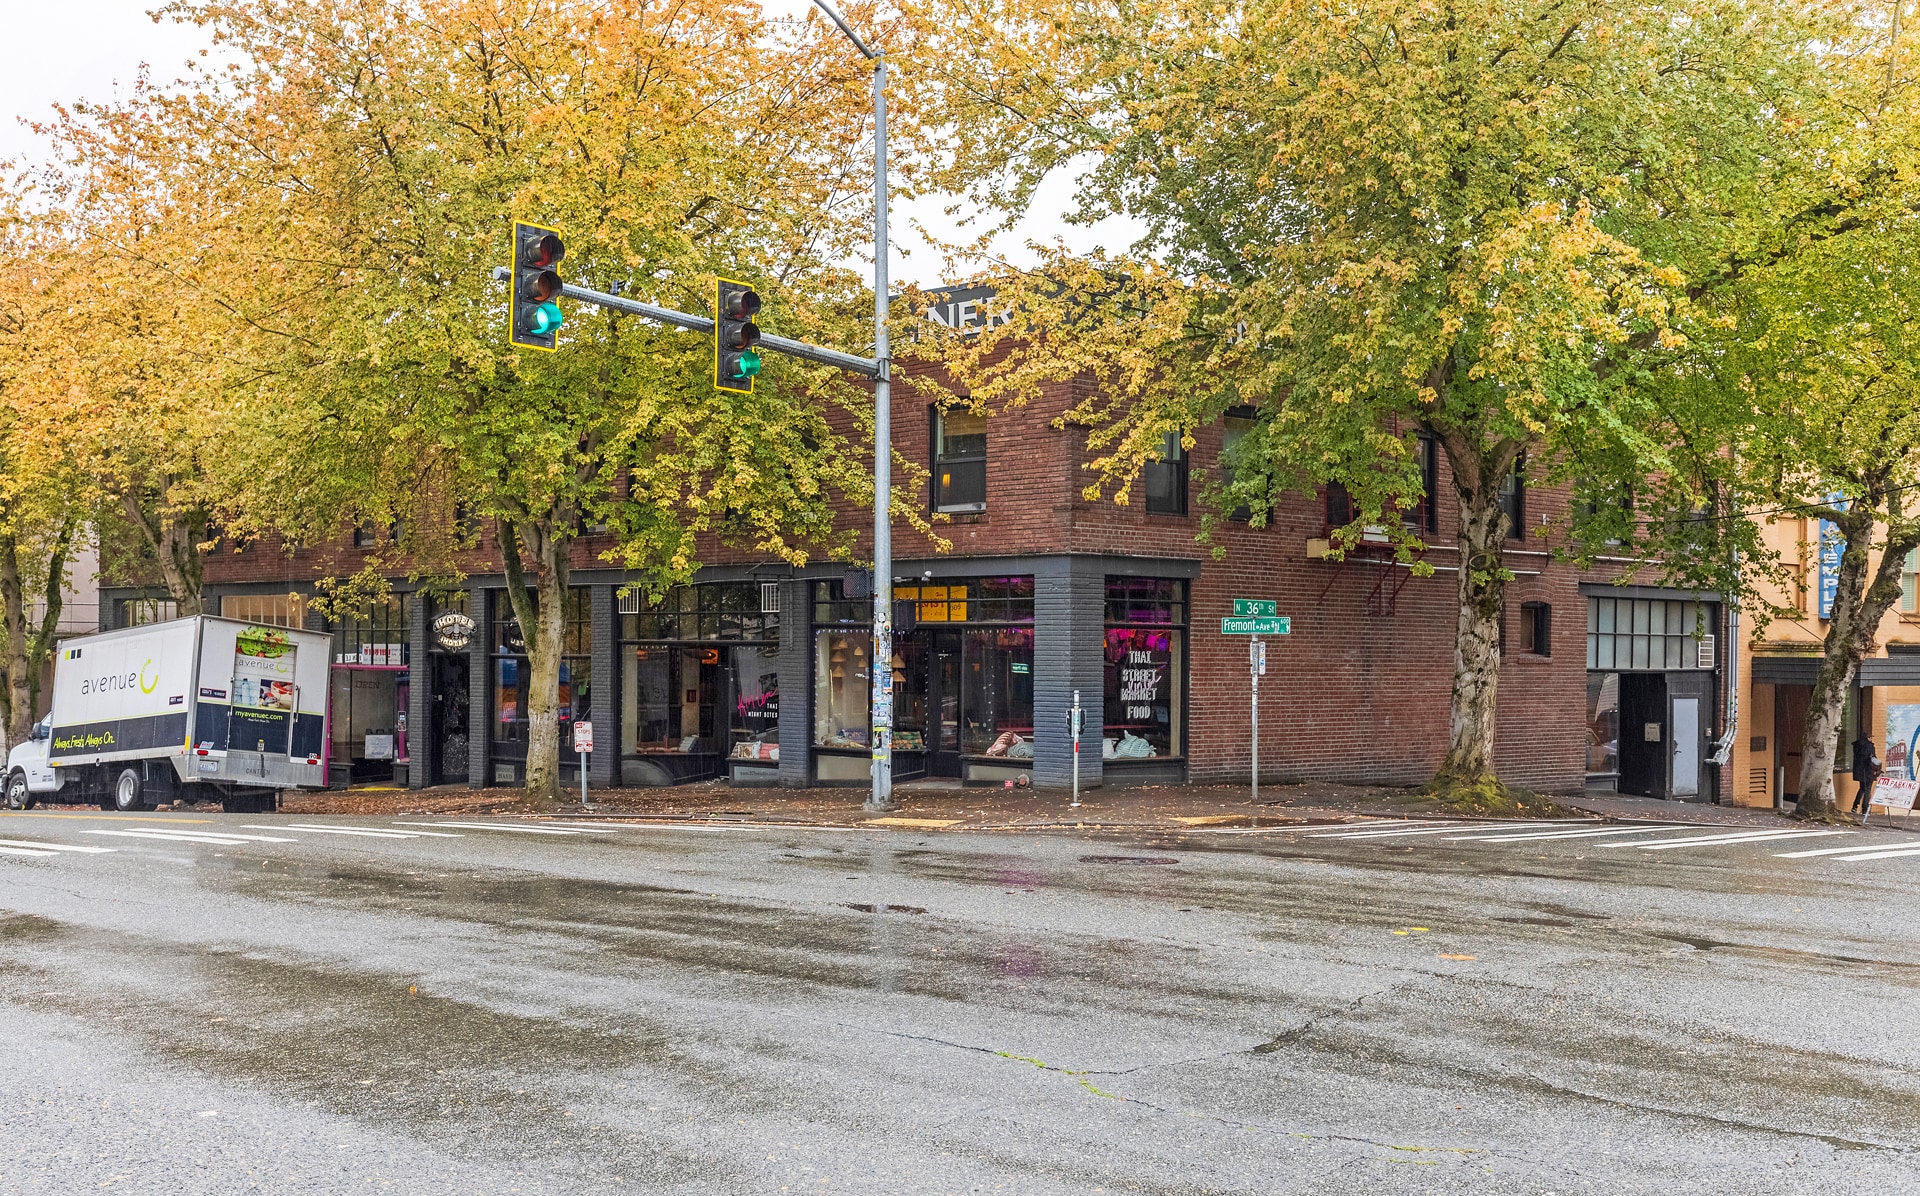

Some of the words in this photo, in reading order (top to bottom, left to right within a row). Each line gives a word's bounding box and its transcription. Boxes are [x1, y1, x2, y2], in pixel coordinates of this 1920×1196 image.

[1268, 604, 1275, 614] St
[435, 614, 475, 629] HOTEL
[1224, 620, 1256, 631] Fremont
[1260, 622, 1270, 630] Ave
[1130, 651, 1151, 663] THAI
[238, 659, 275, 670] avenue
[1122, 669, 1156, 682] STREET
[82, 672, 136, 694] avenue
[1121, 688, 1157, 700] MARKET
[235, 710, 283, 720] myavenuec.com
[1127, 706, 1150, 719] FOOD
[52, 737, 70, 750] Always
[85, 733, 103, 748] Always
[1890, 780, 1916, 790] PARKING
